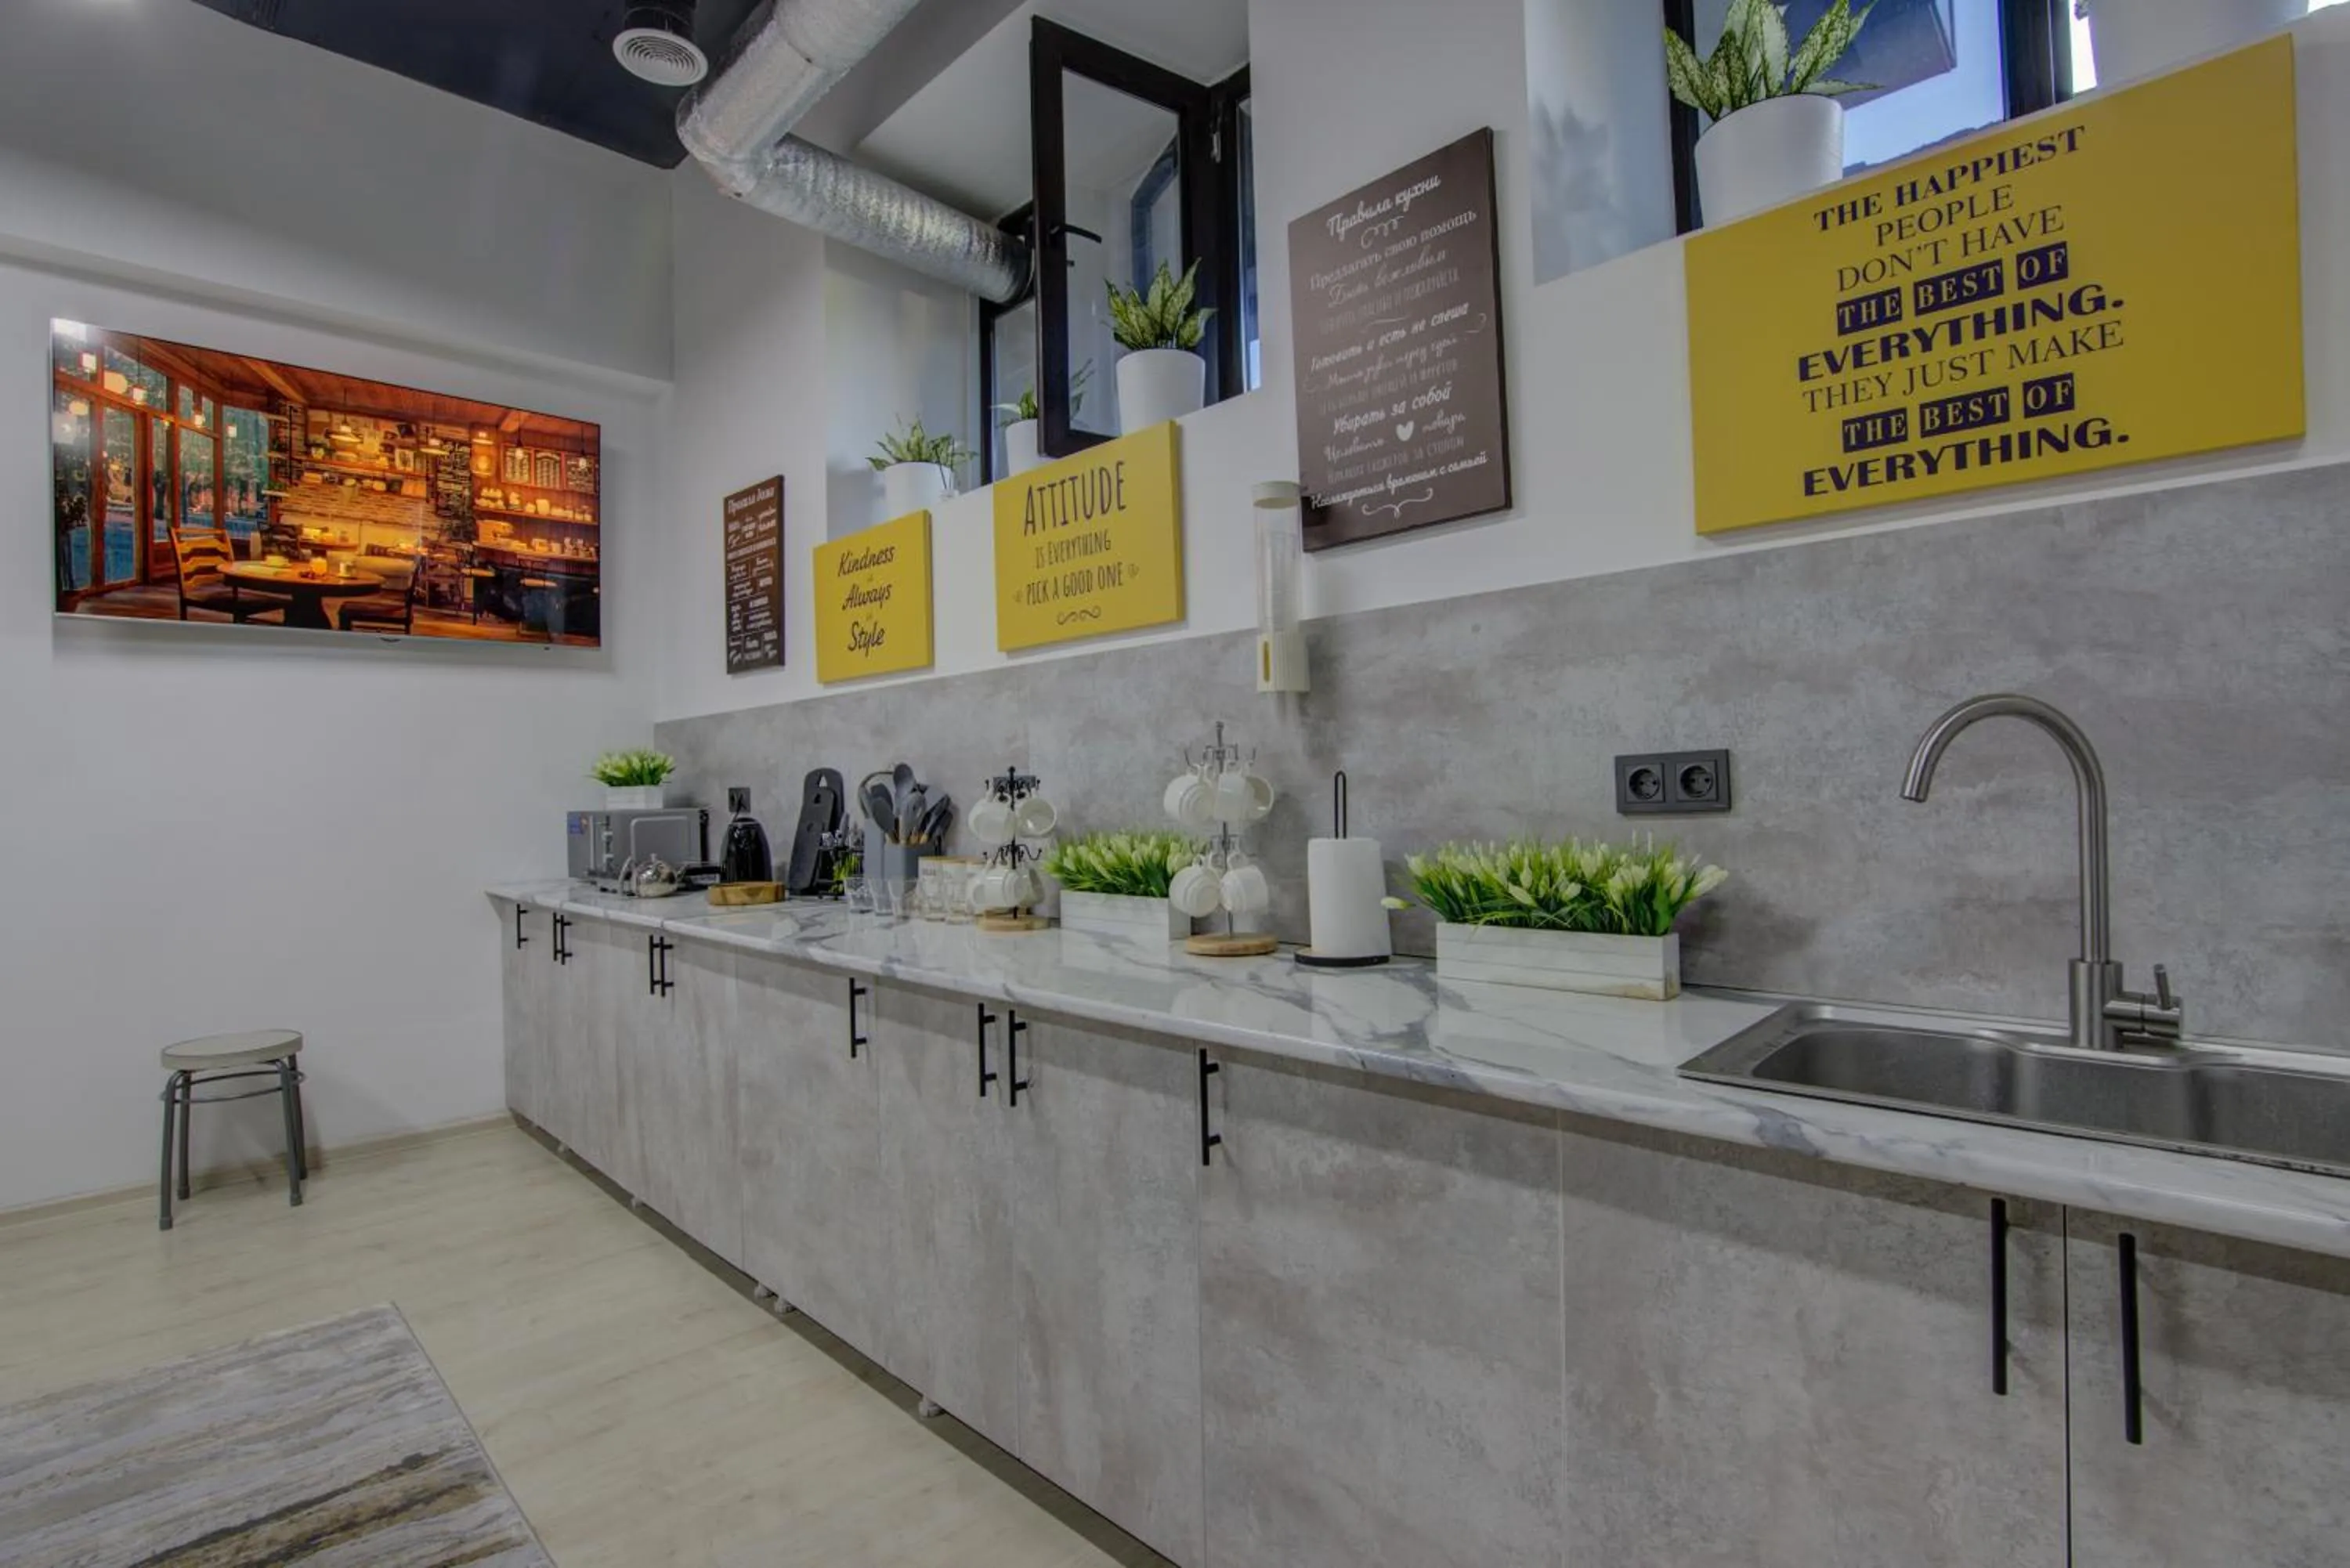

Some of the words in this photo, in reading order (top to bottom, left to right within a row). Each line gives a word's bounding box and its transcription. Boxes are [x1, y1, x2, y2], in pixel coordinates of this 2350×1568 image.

[1326, 198, 1393, 242] Правила
[1395, 175, 1441, 212] кухни
[1813, 192, 1883, 232] THE
[1896, 125, 2085, 207] HAPPIEST
[1836, 239, 1948, 292] DON'T
[1961, 205, 2065, 258] HAVE
[1875, 184, 2014, 247] PEOPLE
[1837, 290, 1902, 331] THE
[1915, 263, 2003, 313] BEST
[2017, 245, 2067, 284] OF
[1799, 284, 2125, 382] EVERYTHING.
[1802, 371, 1893, 414] THEY
[1902, 349, 1996, 396] JUST
[2007, 320, 2125, 370] MAKE
[1333, 408, 1386, 435] Убирать
[1390, 400, 1407, 417] за
[1412, 381, 1453, 410] собой
[1843, 410, 1907, 450] THE
[1921, 390, 2008, 435] BEST
[2023, 376, 2073, 413] OF
[1803, 417, 2130, 497] EVERYTHING.
[1024, 461, 1126, 537] ATTITUDE
[837, 546, 895, 577] Kindness
[1026, 579, 1050, 605] PICK
[1052, 576, 1060, 600] A
[1063, 569, 1093, 598] GOOD
[1097, 562, 1124, 591] ONE
[1036, 546, 1045, 570] IS
[1048, 529, 1112, 565] EVERYTHING
[841, 582, 892, 611] Always
[847, 620, 885, 658] Style
